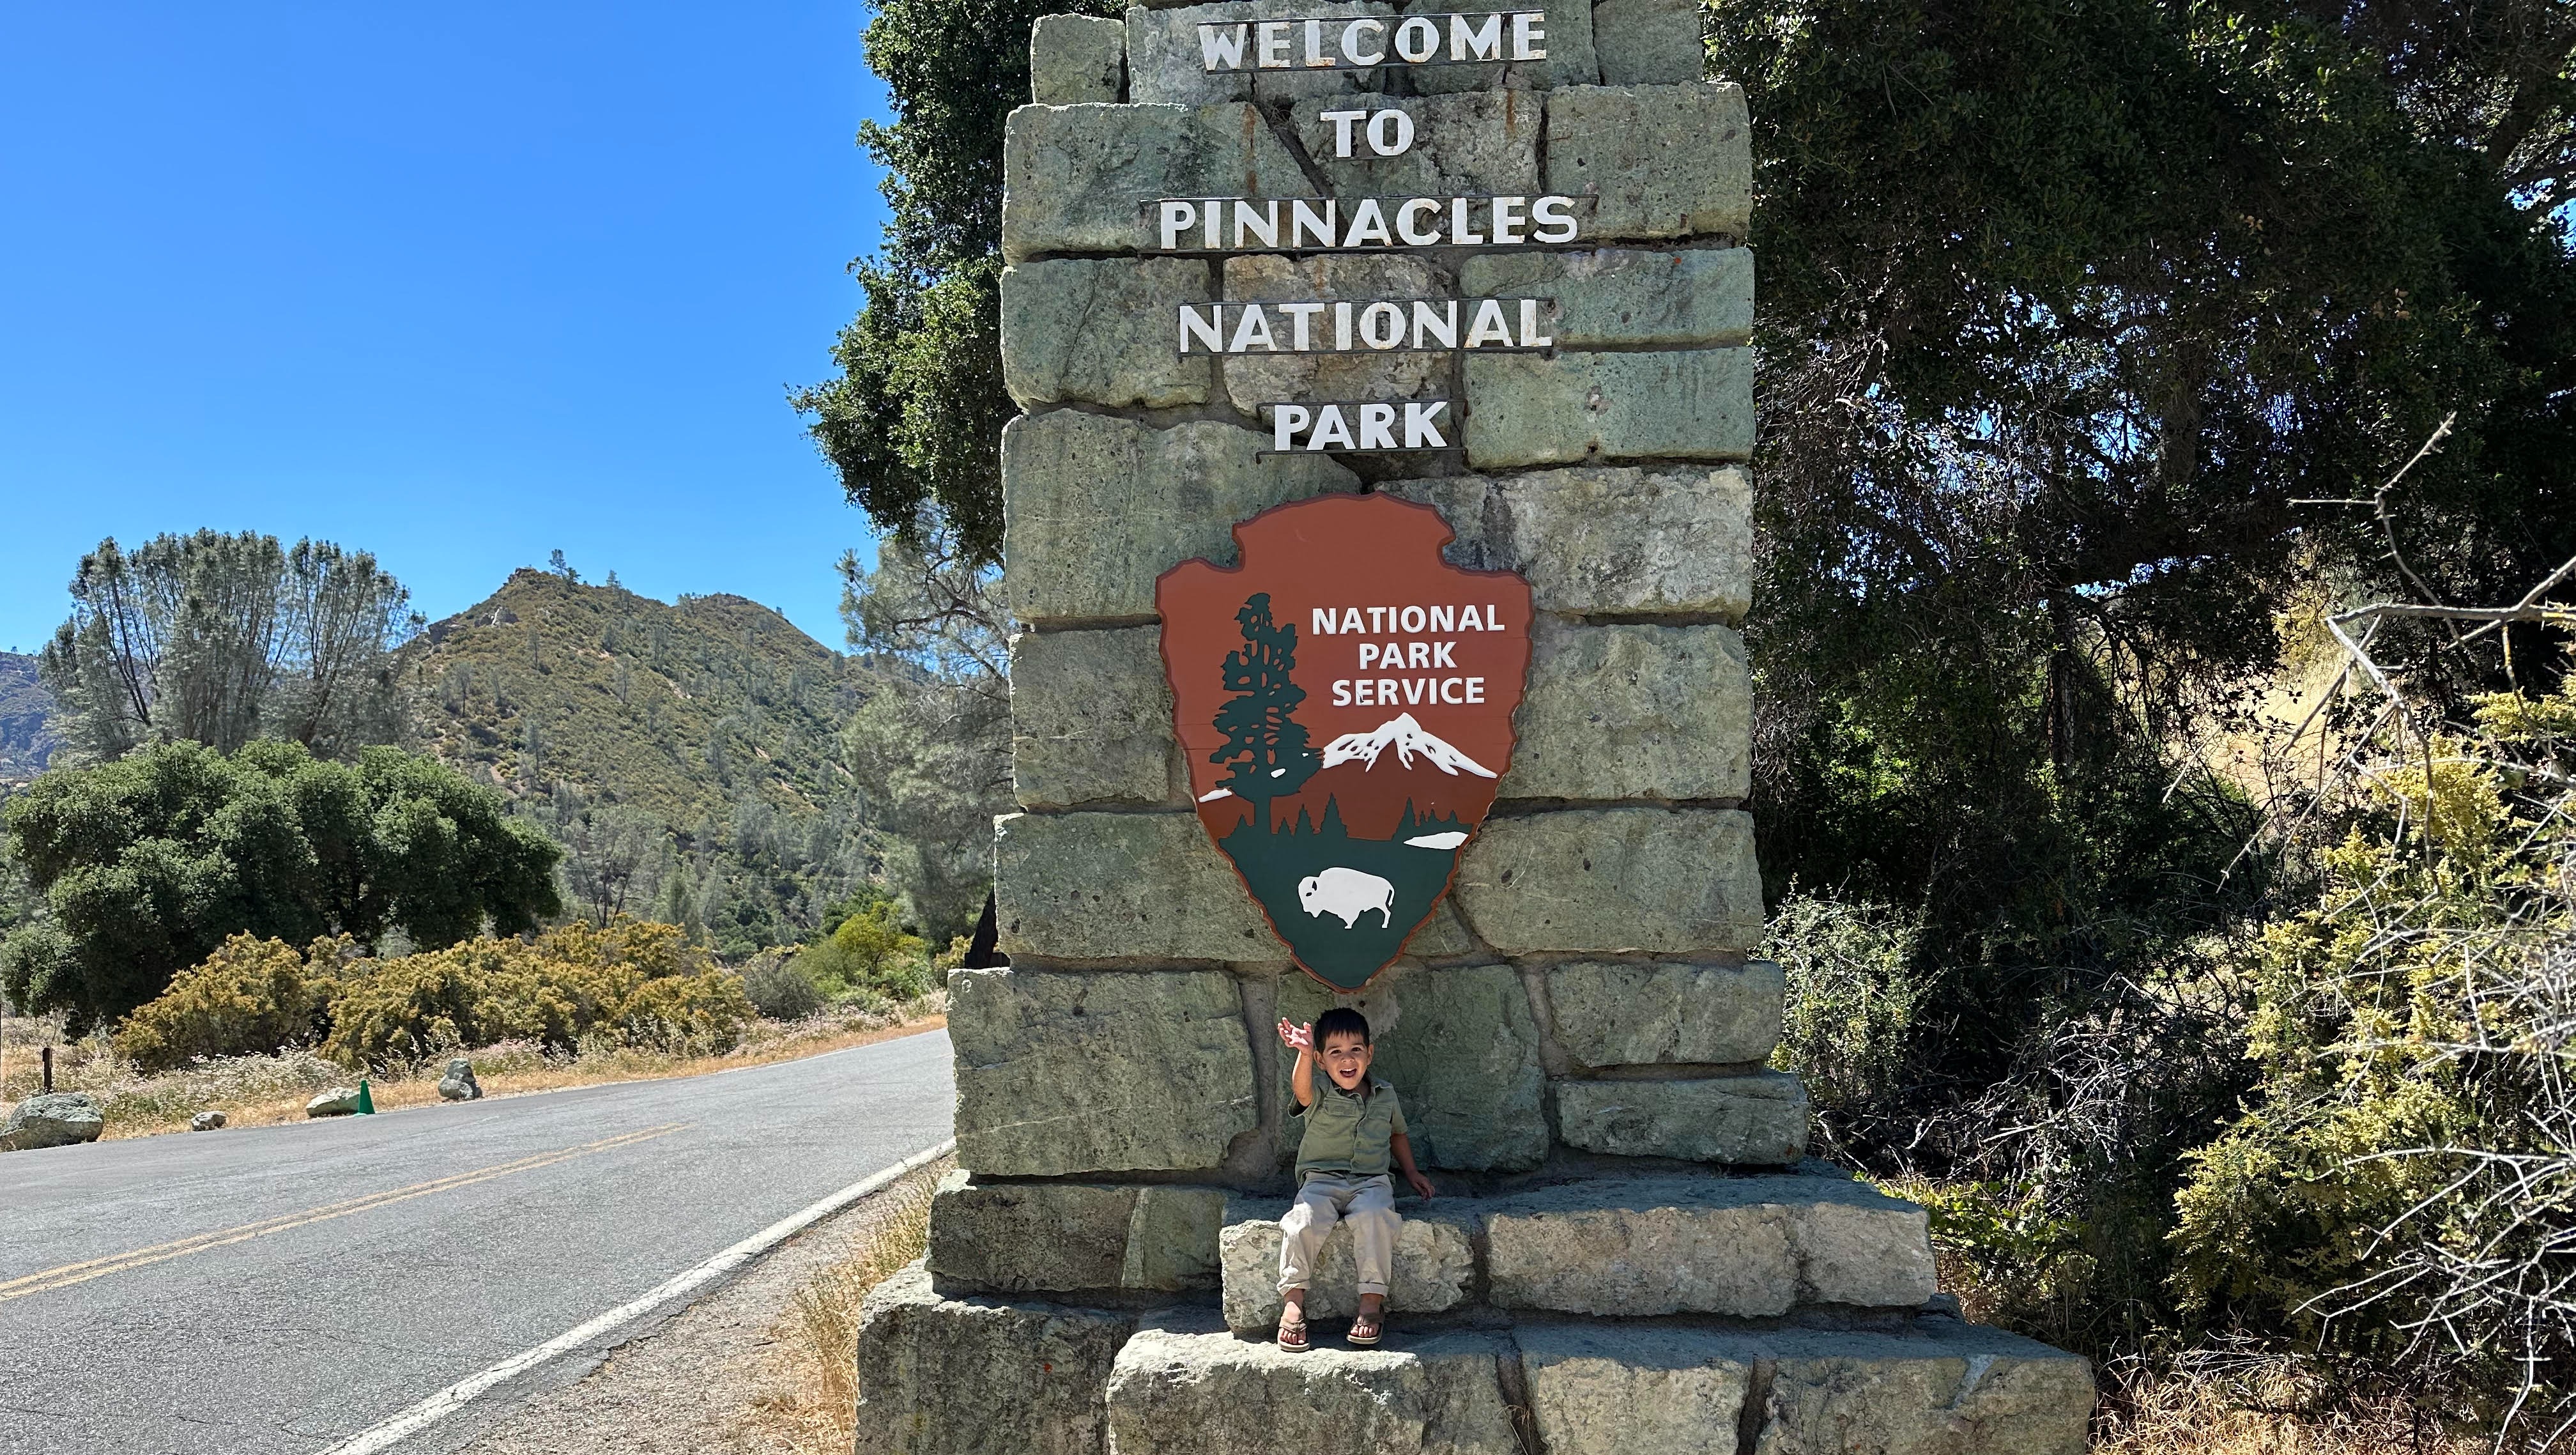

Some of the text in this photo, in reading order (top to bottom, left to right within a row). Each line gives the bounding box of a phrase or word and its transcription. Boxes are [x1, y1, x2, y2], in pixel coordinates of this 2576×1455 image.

[1199, 13, 1547, 70] WELCOME
[1321, 109, 1414, 157] TO
[1160, 197, 1577, 249] PINNACLES
[1179, 299, 1552, 352] NATIONAL
[1274, 401, 1447, 450] PARK
[1312, 604, 1505, 634] NATIONAL
[1359, 642, 1458, 670] PARK
[1332, 677, 1485, 706] SERVICE
